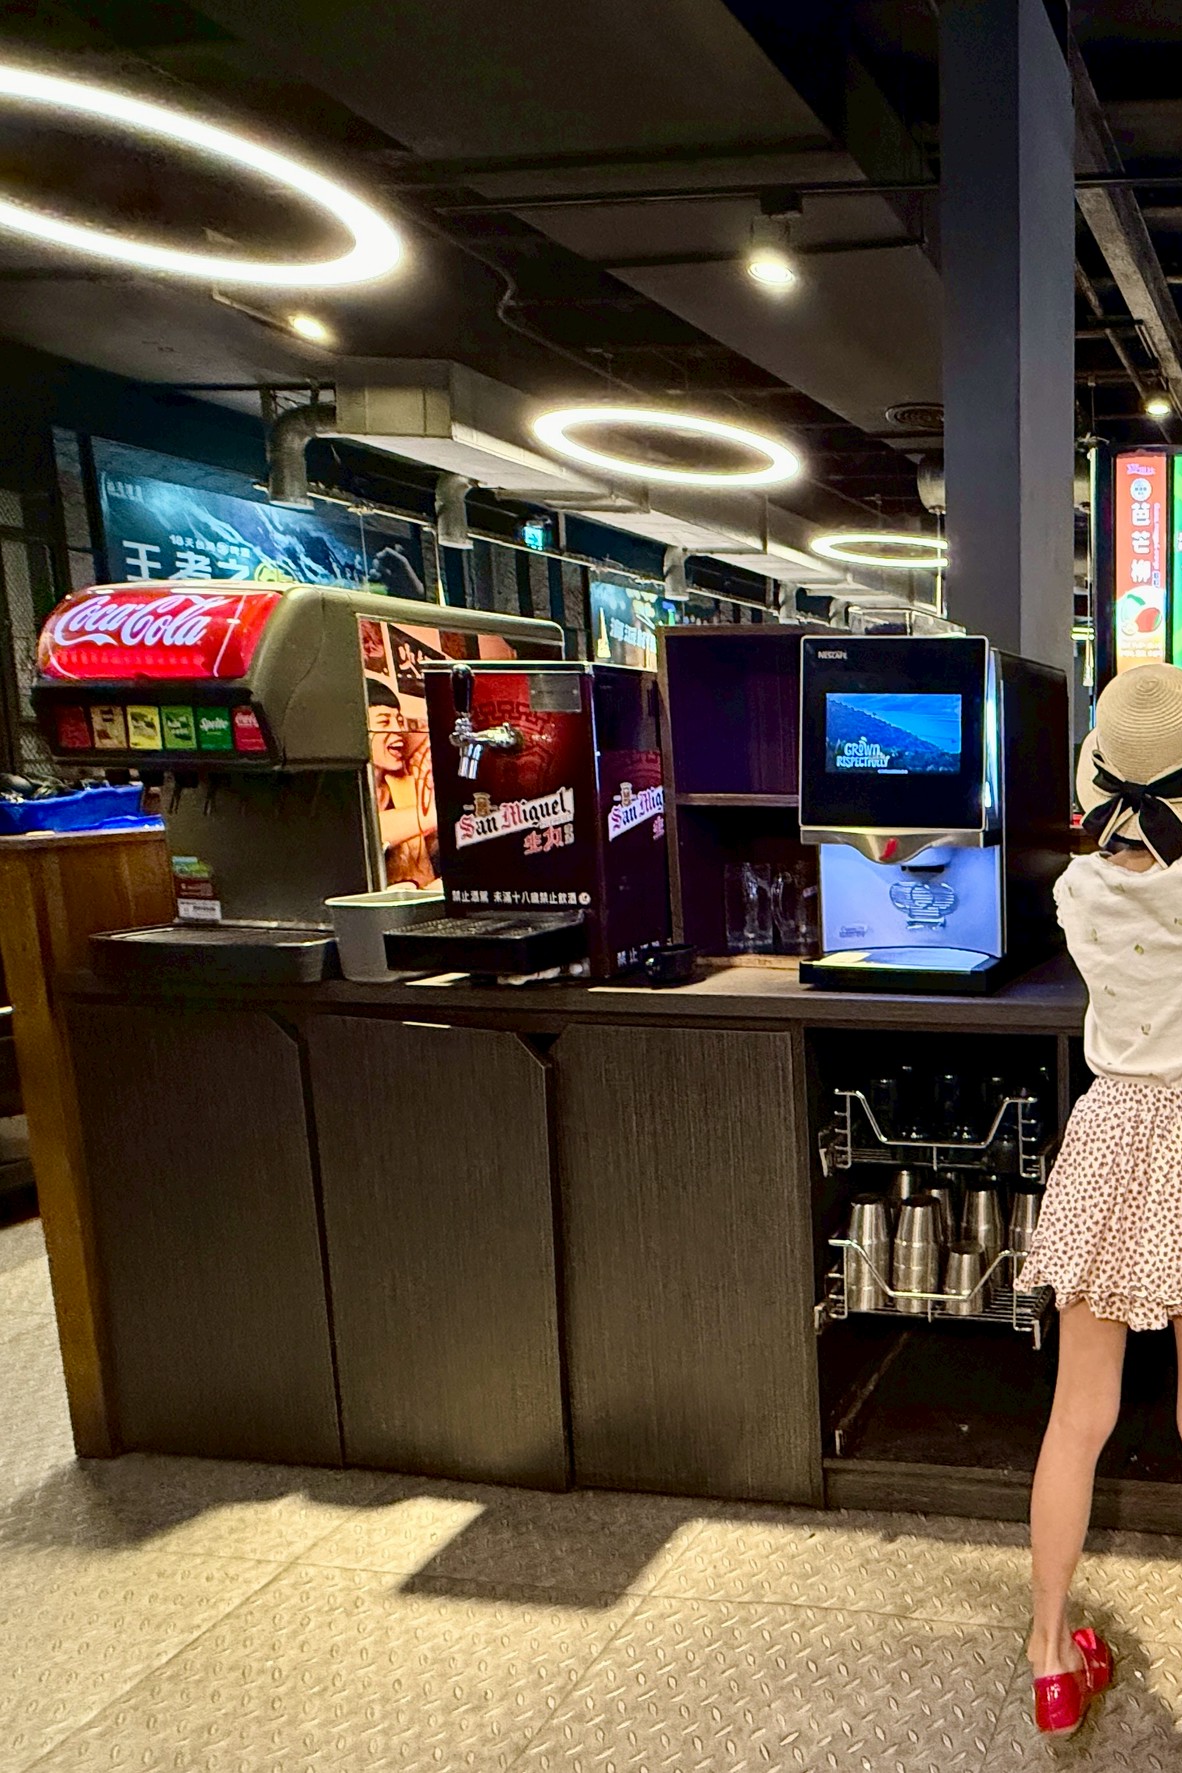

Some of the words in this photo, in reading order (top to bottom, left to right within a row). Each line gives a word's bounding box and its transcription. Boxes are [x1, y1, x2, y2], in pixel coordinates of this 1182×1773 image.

[54, 595, 236, 646] Coca-Cola
[459, 813, 498, 840] San
[500, 790, 572, 829] Miguel
[611, 804, 638, 831] San
[638, 789, 664, 817] Mig
